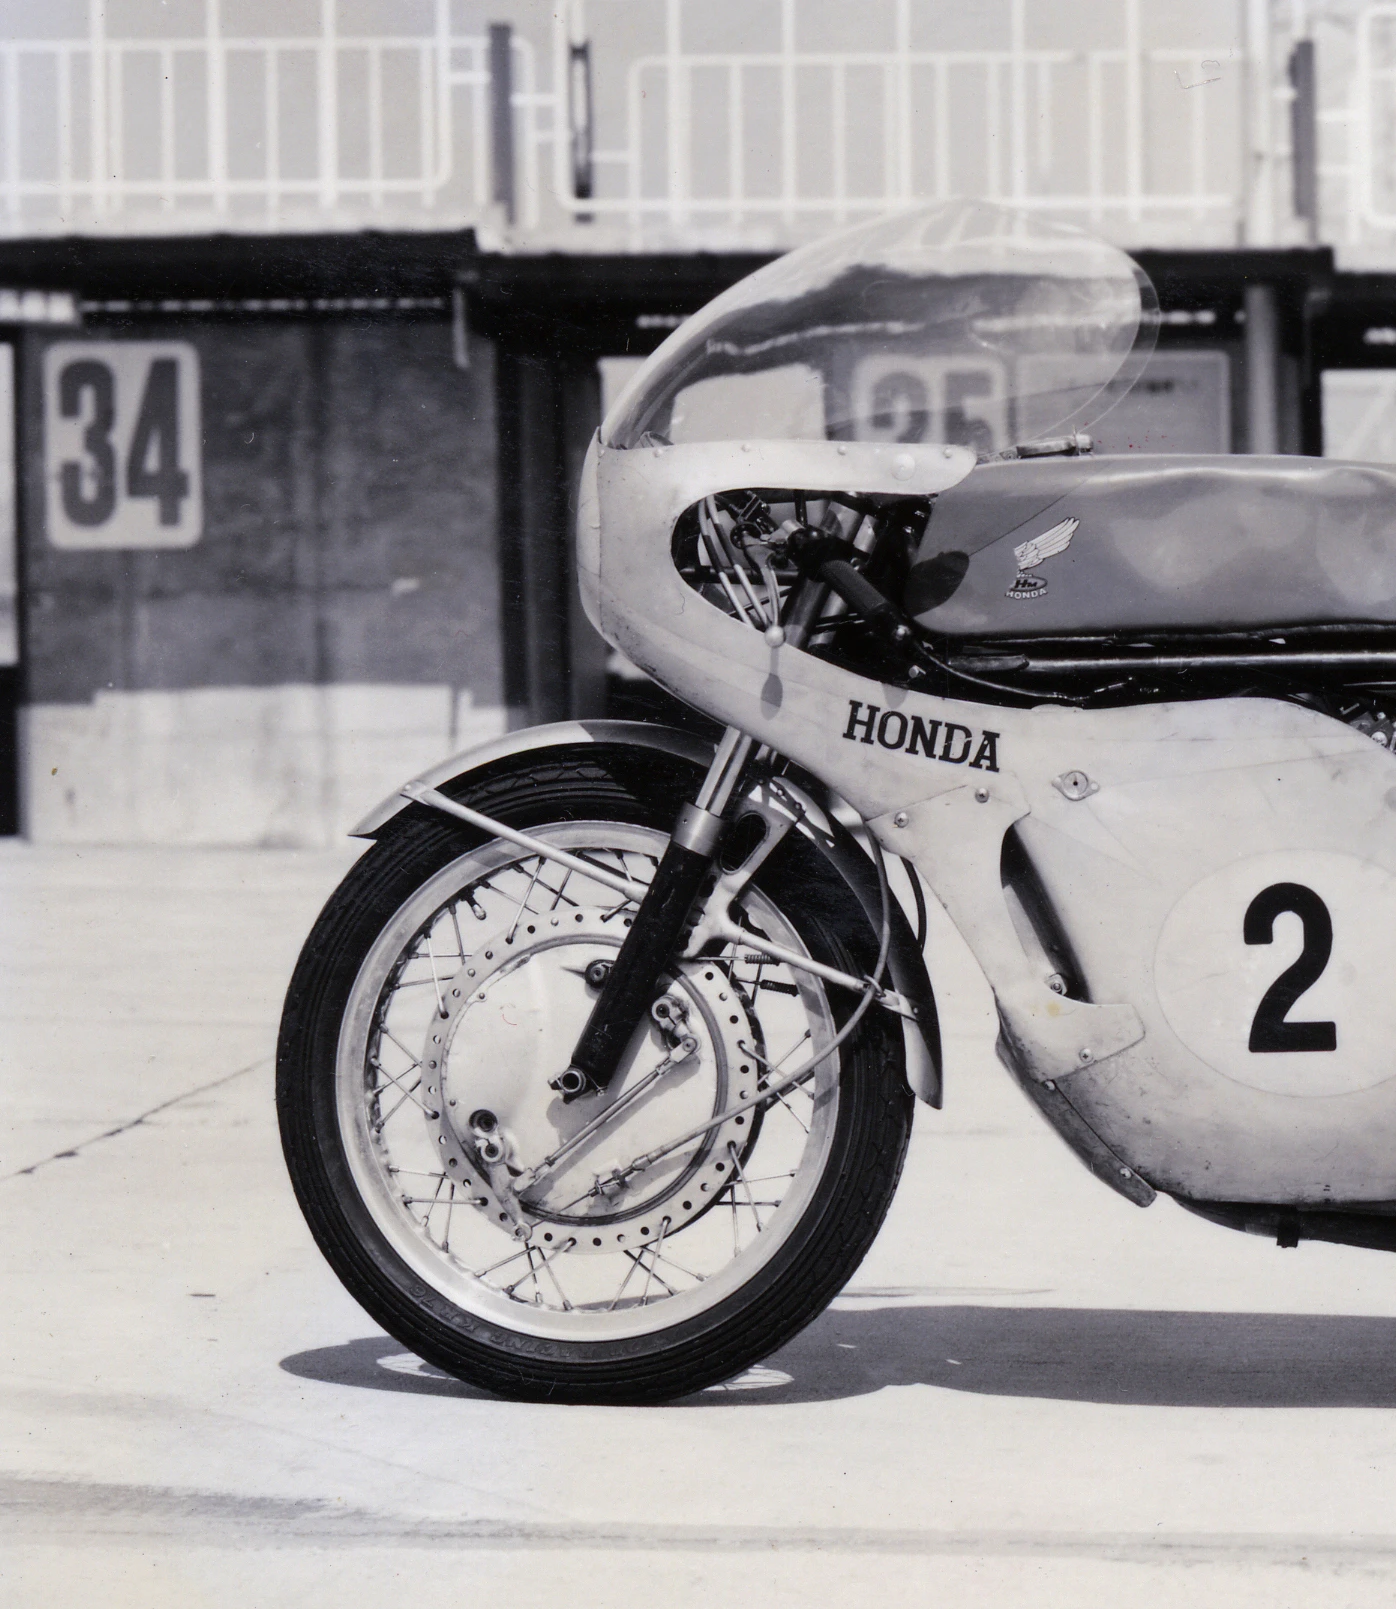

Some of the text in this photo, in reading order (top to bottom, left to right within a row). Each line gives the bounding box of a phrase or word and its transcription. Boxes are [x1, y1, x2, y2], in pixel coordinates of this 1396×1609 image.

[58, 358, 190, 526] 34
[1004, 589, 1048, 600] HONDA
[842, 700, 1000, 773] HONDA
[1243, 882, 1337, 1053] 2
